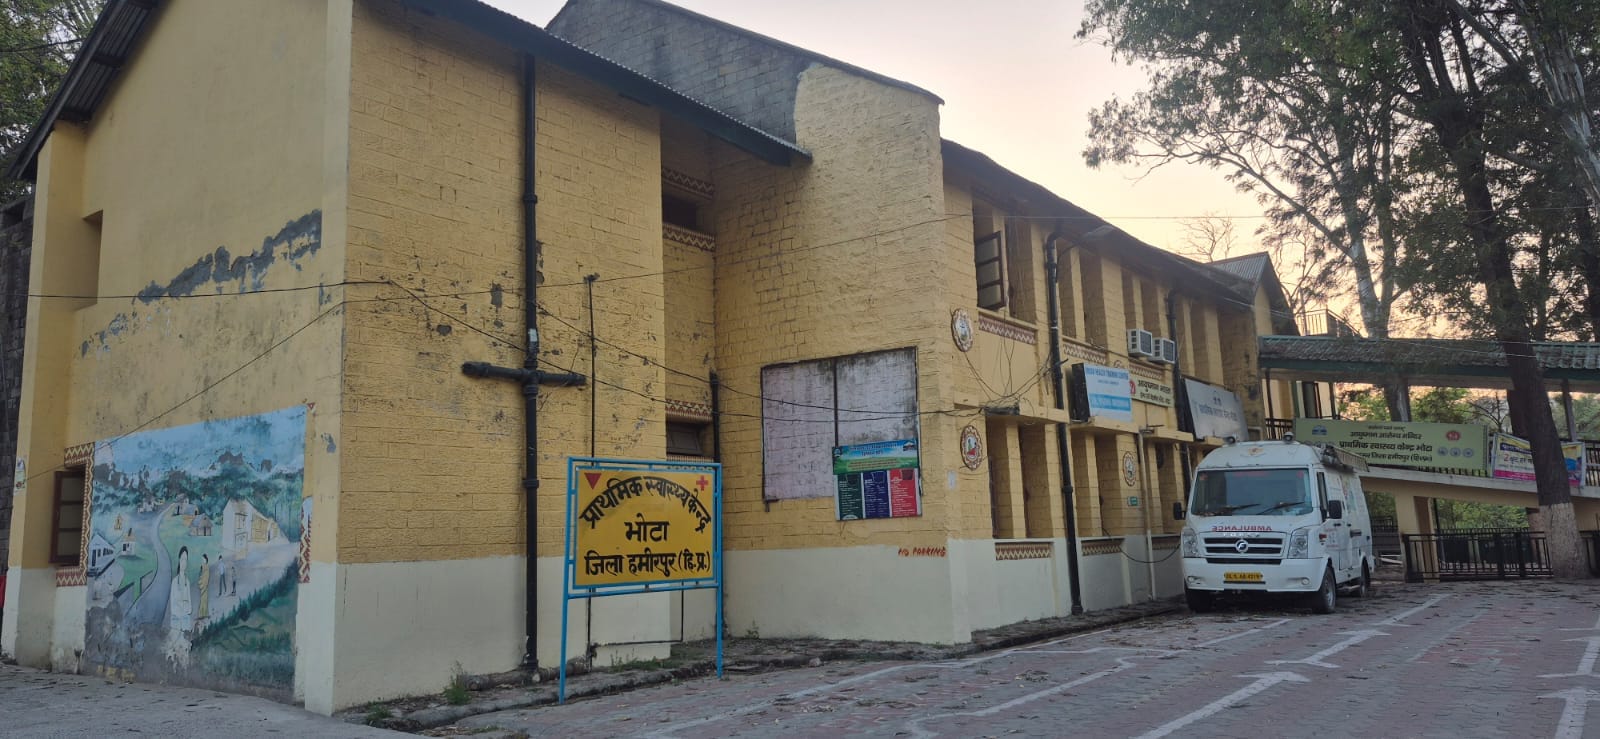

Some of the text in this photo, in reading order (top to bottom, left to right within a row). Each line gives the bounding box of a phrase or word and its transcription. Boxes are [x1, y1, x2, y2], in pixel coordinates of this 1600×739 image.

[1350, 431, 1377, 440] आयुष्मान
[1339, 440, 1432, 452] प्राथमिक स्वास्थ्य केन्द्र भोटा
[579, 475, 712, 533] प्राथमिक स्वास्थ्य केन्द्र
[624, 513, 670, 542] भोटा
[913, 546, 946, 557] PARKING
[584, 548, 711, 577] जिला हमीरपुर (हि.प्र.)
